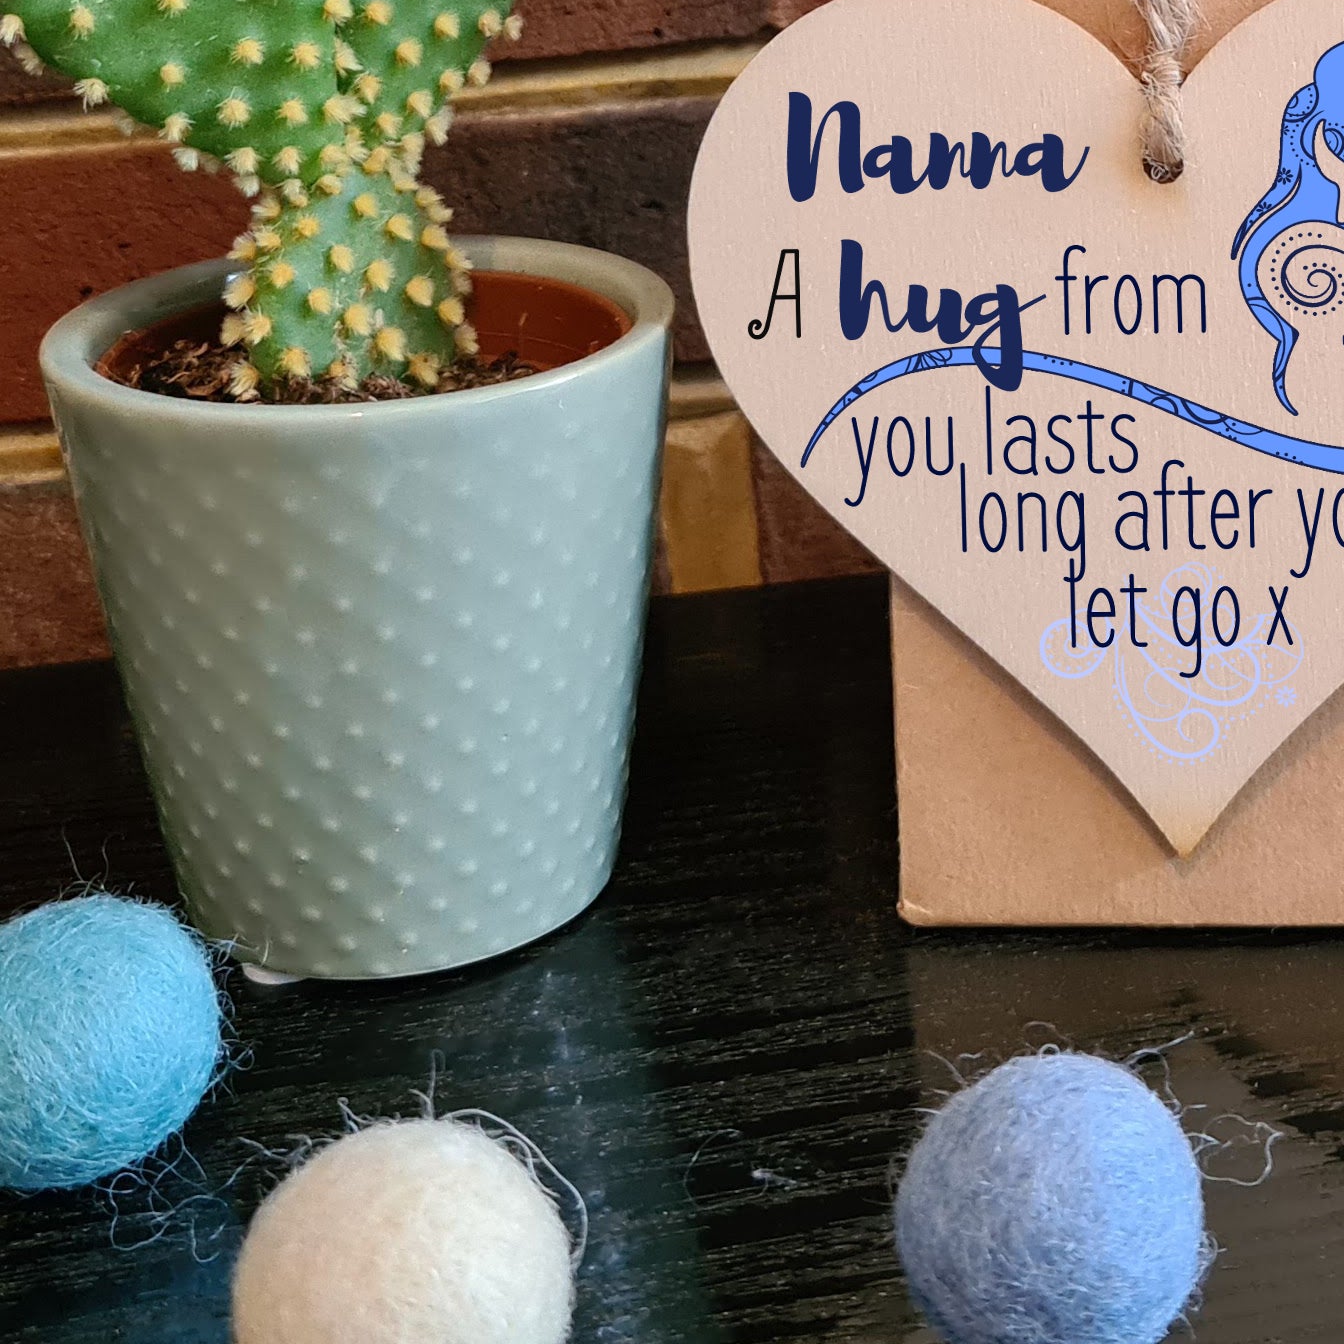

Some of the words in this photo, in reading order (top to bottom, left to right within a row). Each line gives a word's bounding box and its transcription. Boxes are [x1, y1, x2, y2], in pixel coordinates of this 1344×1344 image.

[787, 91, 1090, 202] Nanna
[747, 249, 801, 339] A
[839, 239, 1047, 392] hug
[1055, 245, 1207, 335] from
[844, 416, 954, 507] you
[986, 386, 1139, 475] lasts
[960, 463, 1085, 582] long
[1115, 460, 1273, 551] after
[1065, 558, 1148, 648] let
[1172, 586, 1241, 678] go
[1266, 586, 1293, 646] x
